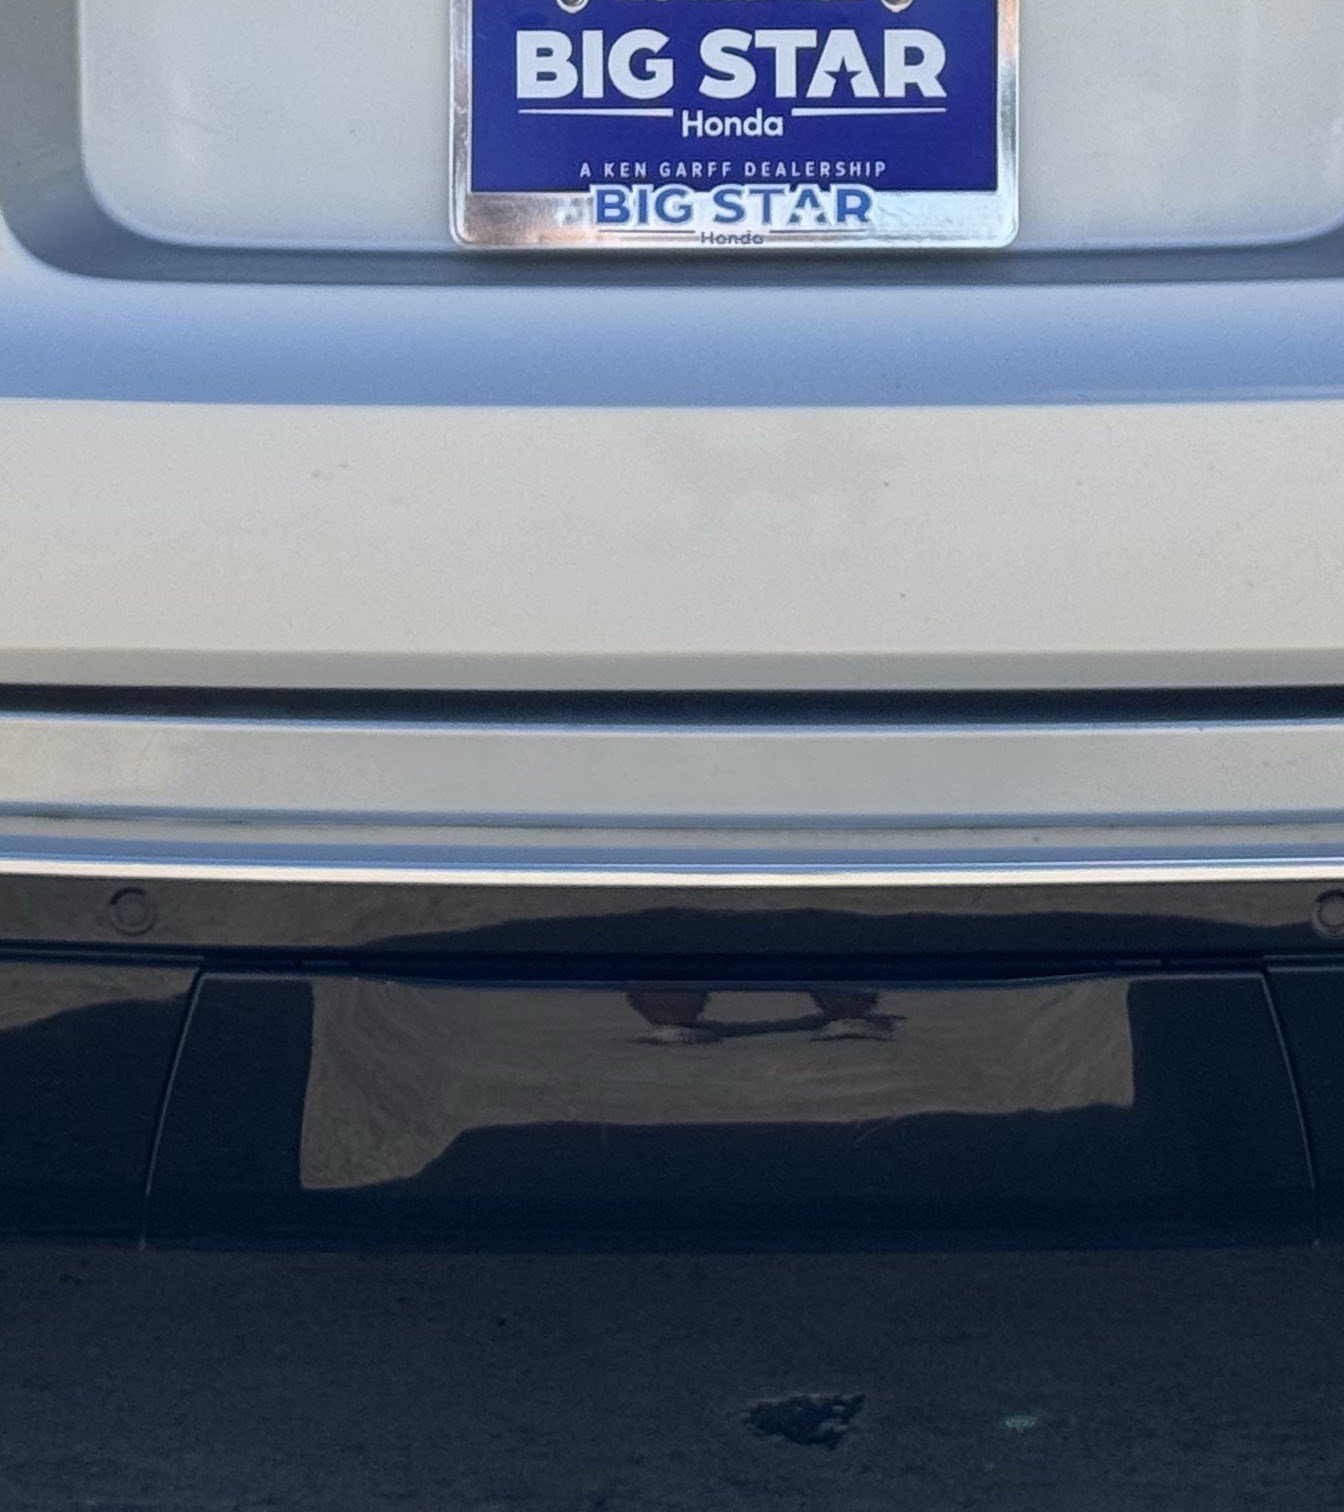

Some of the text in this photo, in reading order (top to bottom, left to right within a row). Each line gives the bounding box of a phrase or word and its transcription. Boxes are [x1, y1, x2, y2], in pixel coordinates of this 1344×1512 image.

[516, 28, 947, 100] BIG STAR
[681, 107, 784, 138] Honda
[579, 161, 887, 178] A KEN GARFF DEALERSHIP
[595, 187, 873, 225] BIG STAR
[700, 229, 765, 246] Honda
